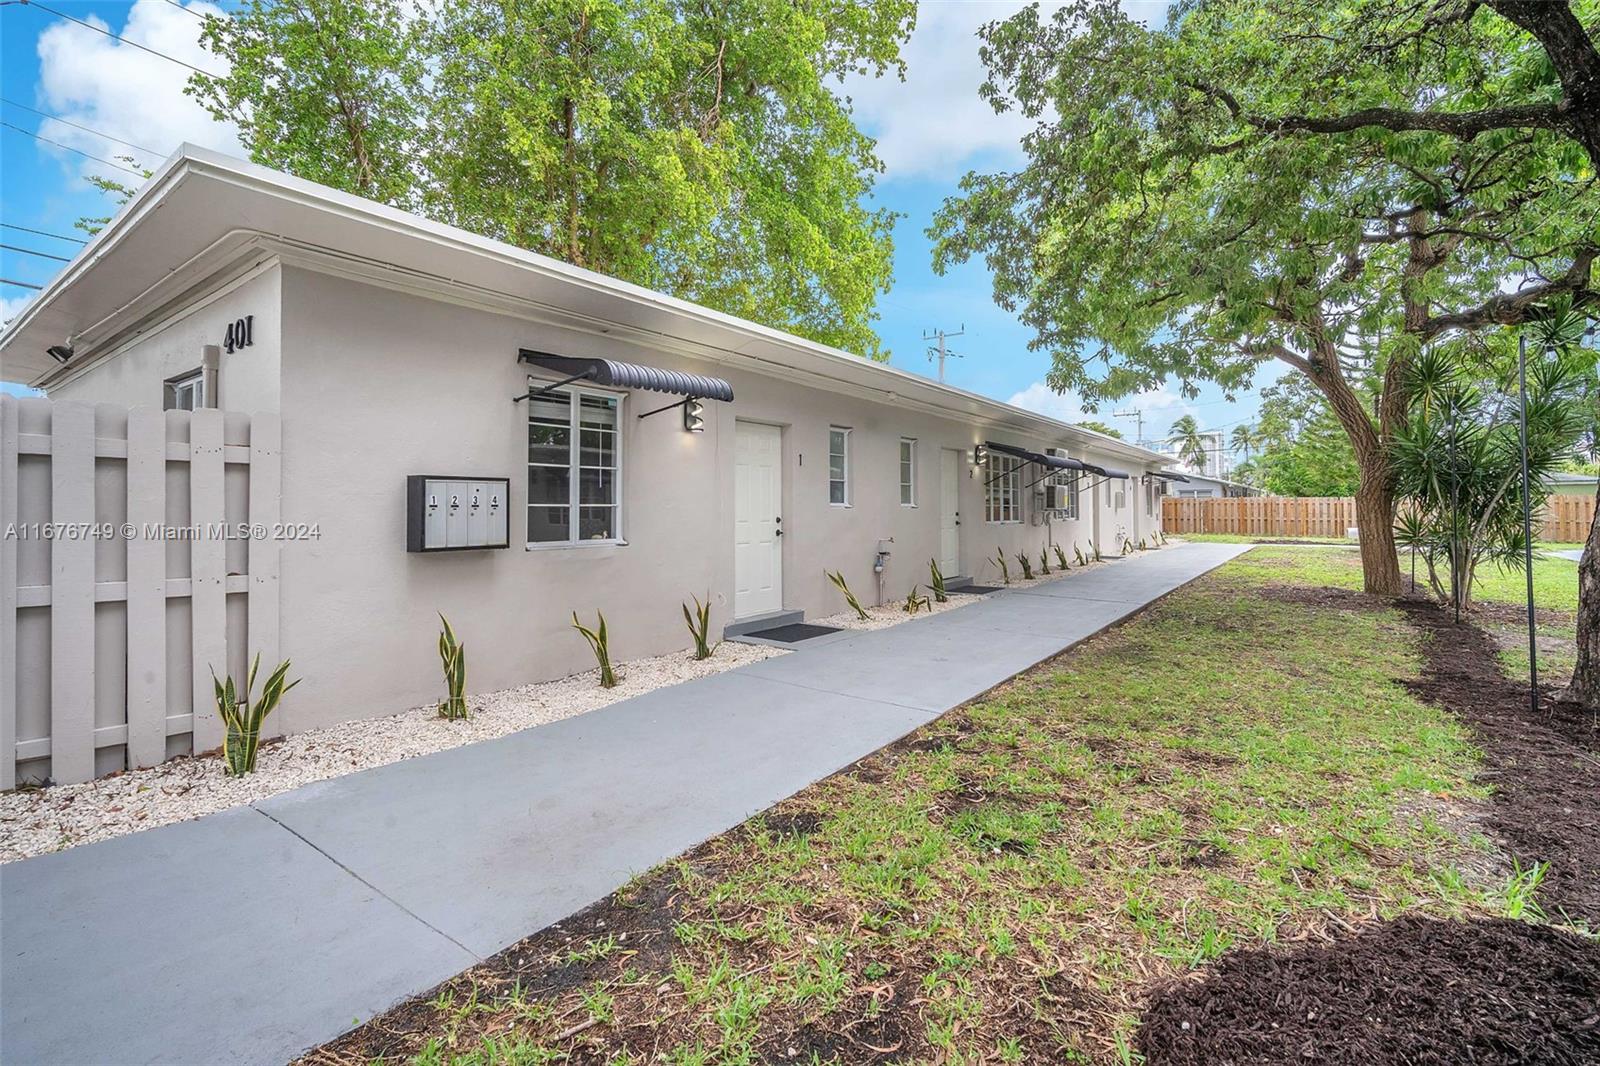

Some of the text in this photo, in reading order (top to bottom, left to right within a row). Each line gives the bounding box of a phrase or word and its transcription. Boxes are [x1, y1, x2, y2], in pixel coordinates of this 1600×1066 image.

[223, 315, 254, 354] 401
[431, 496, 497, 504] 1 2 3 4
